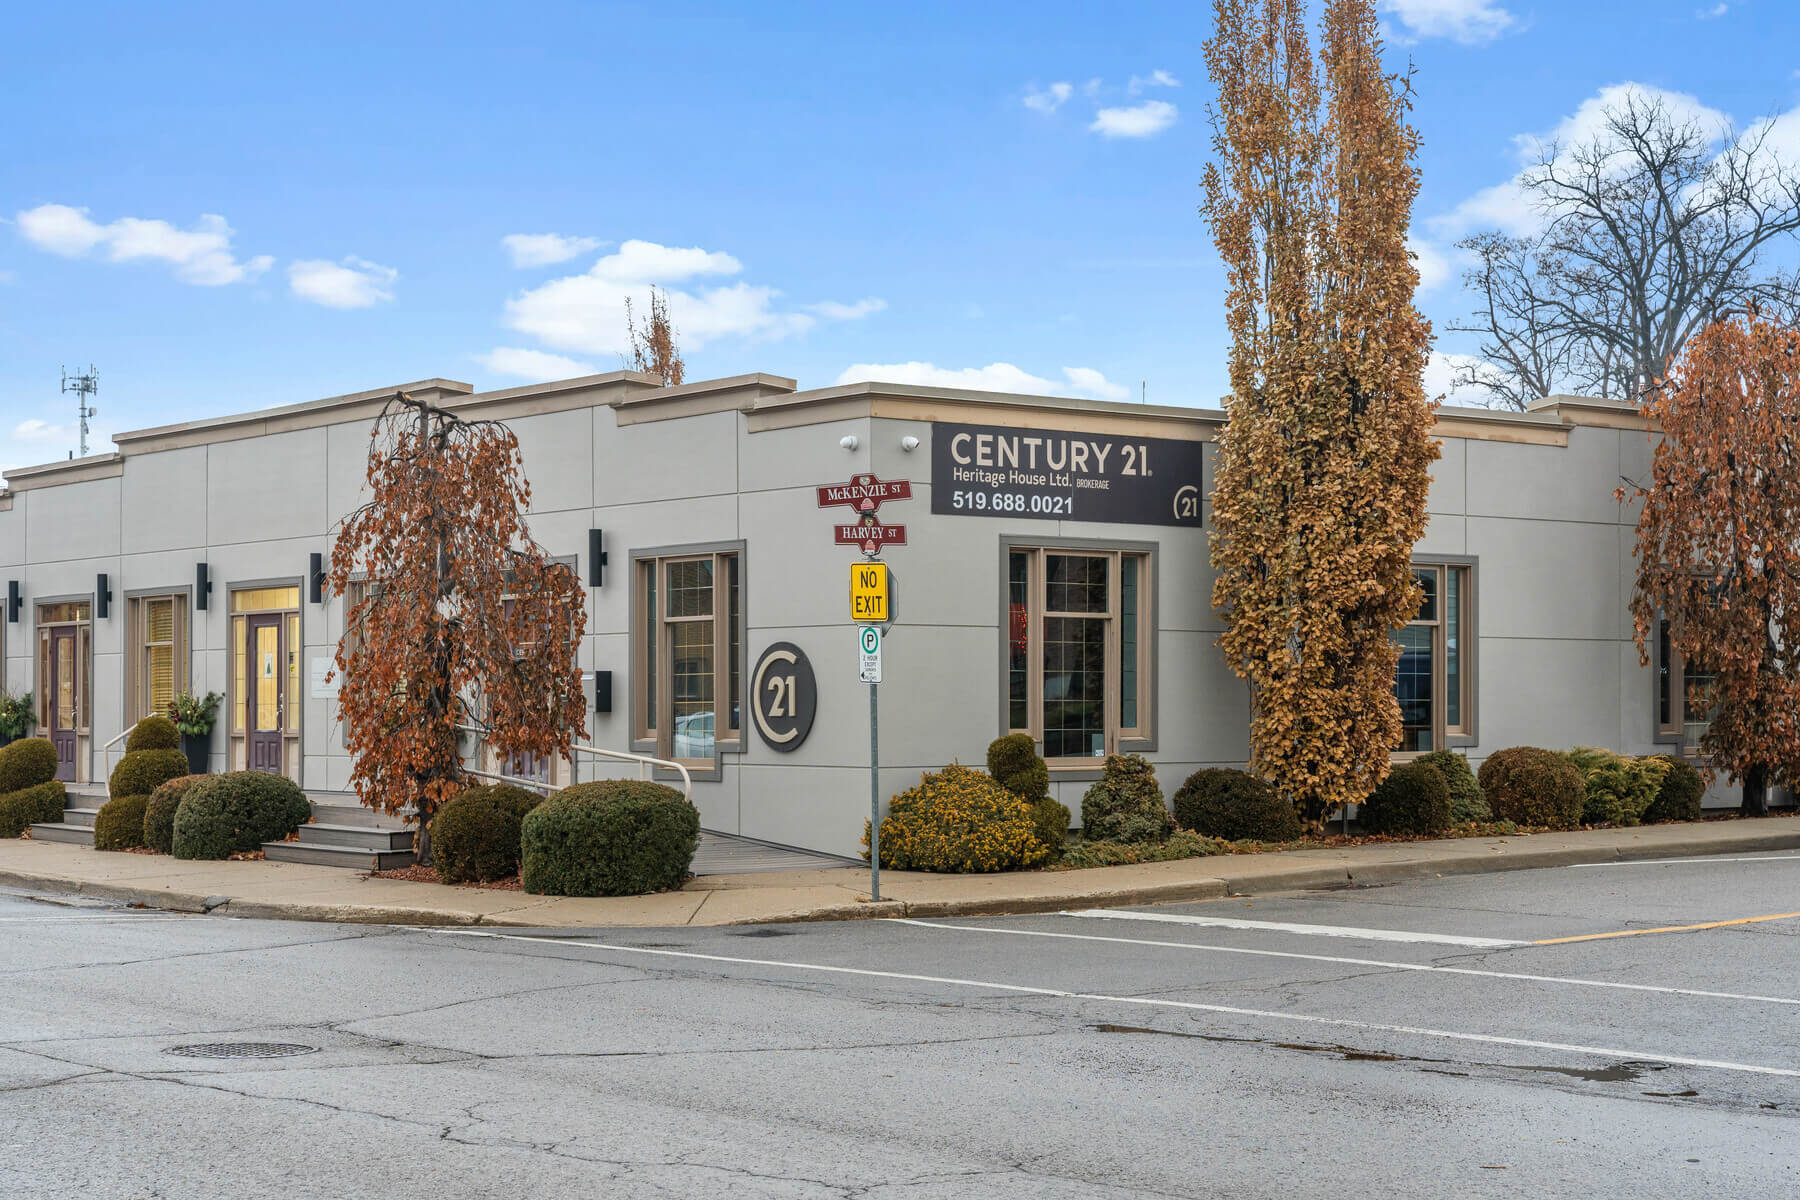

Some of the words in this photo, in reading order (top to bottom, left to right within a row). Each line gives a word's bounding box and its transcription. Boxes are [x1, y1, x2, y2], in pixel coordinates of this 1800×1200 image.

[951, 433, 1112, 473] CENTURY
[953, 467, 1006, 487] Heritage
[1009, 470, 1046, 486] House
[1049, 472, 1073, 487] Ltd.
[1076, 478, 1110, 490] BROKERAGE
[827, 484, 887, 501] McKENZIE
[891, 484, 901, 493] ST
[952, 490, 1072, 514] 519.688.0021
[1181, 497, 1197, 517] 21
[842, 527, 884, 539] HARVEY
[888, 528, 897, 538] ST
[860, 570, 877, 588] NO
[855, 595, 882, 613] EXIT
[867, 634, 874, 648] P
[767, 675, 796, 717] 21
